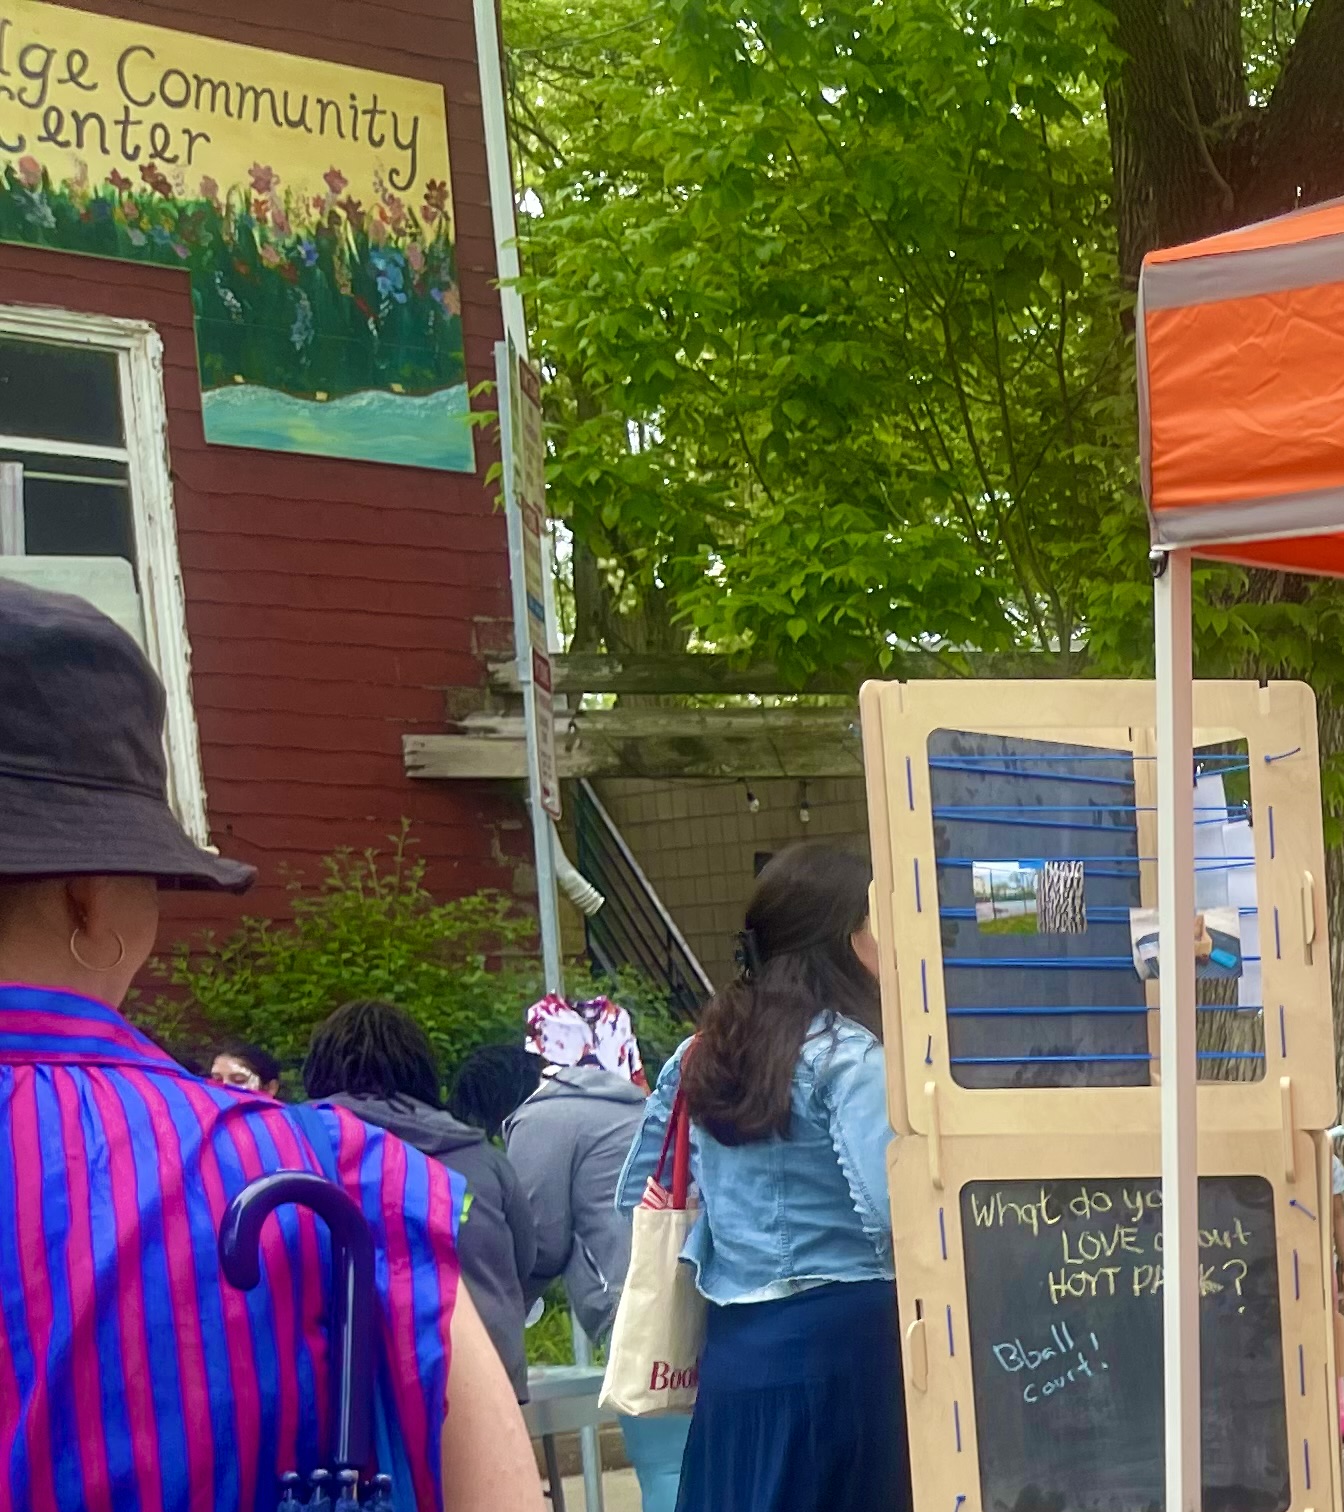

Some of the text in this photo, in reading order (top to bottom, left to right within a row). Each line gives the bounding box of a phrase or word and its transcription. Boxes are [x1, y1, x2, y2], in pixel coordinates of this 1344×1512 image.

[117, 45, 419, 191] Community
[971, 1186, 1163, 1237] What do yo
[1061, 1223, 1144, 1265] LOVE
[1049, 1266, 1121, 1305] HOYT
[649, 1361, 698, 1391] Boo
